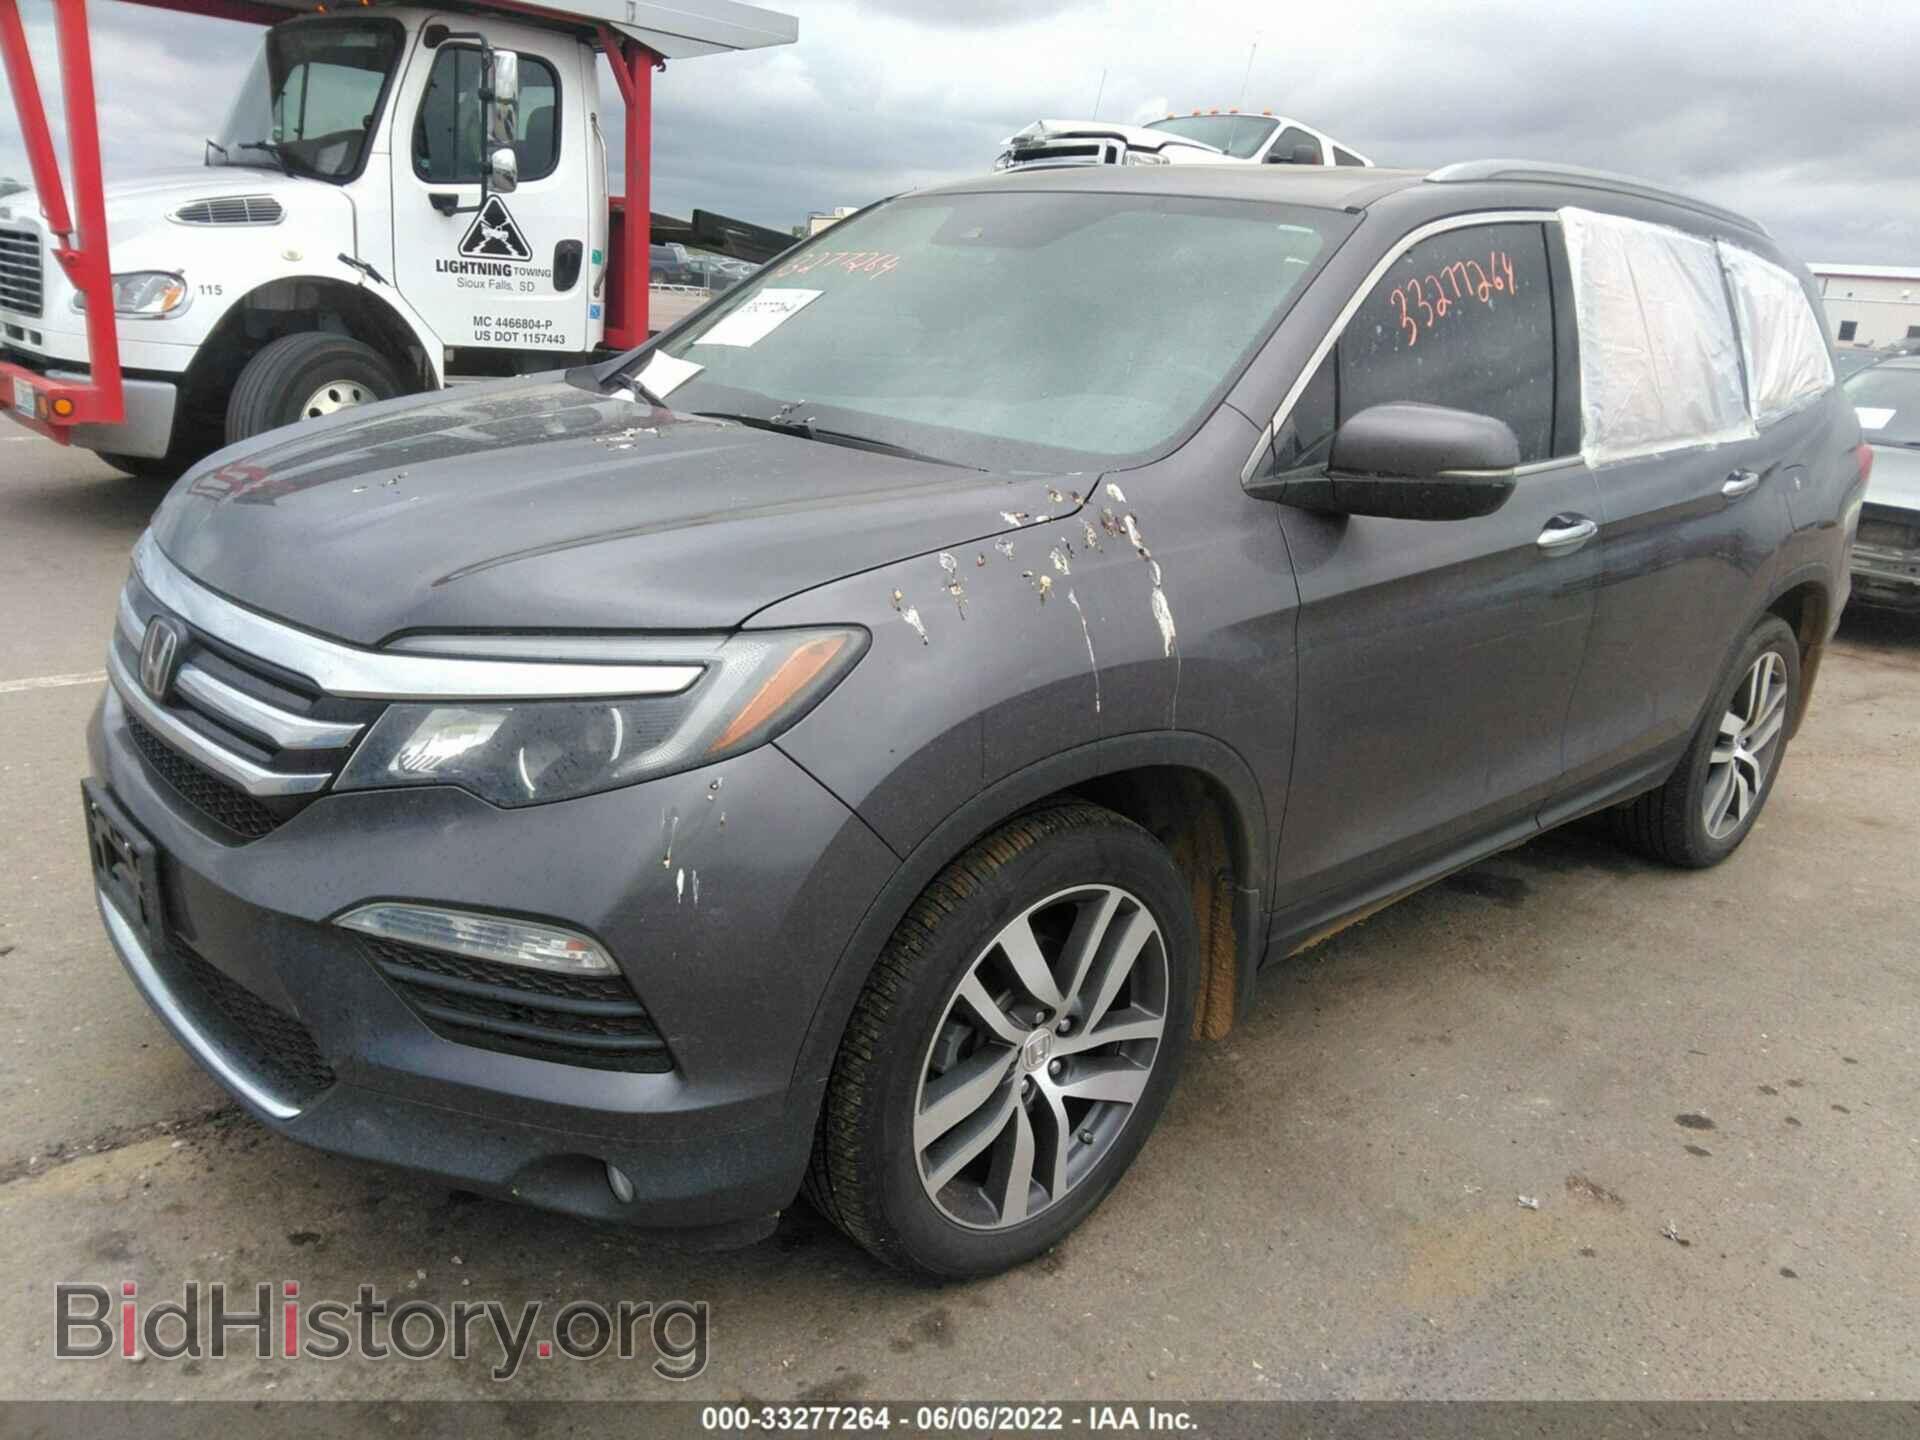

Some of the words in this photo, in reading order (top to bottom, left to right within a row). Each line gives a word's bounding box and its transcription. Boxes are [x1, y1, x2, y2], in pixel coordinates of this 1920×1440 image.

[436, 259, 512, 277] LIGHTNING
[514, 266, 551, 278] TOWING
[198, 284, 223, 296] 115
[456, 277, 485, 289] Sioux
[519, 281, 535, 292] SD
[1390, 251, 1516, 347] 33277264
[473, 316, 492, 327] MC
[495, 318, 553, 330] 4466804-P
[474, 331, 491, 341] US
[494, 331, 519, 343] DOT
[523, 333, 566, 345] 1157443
